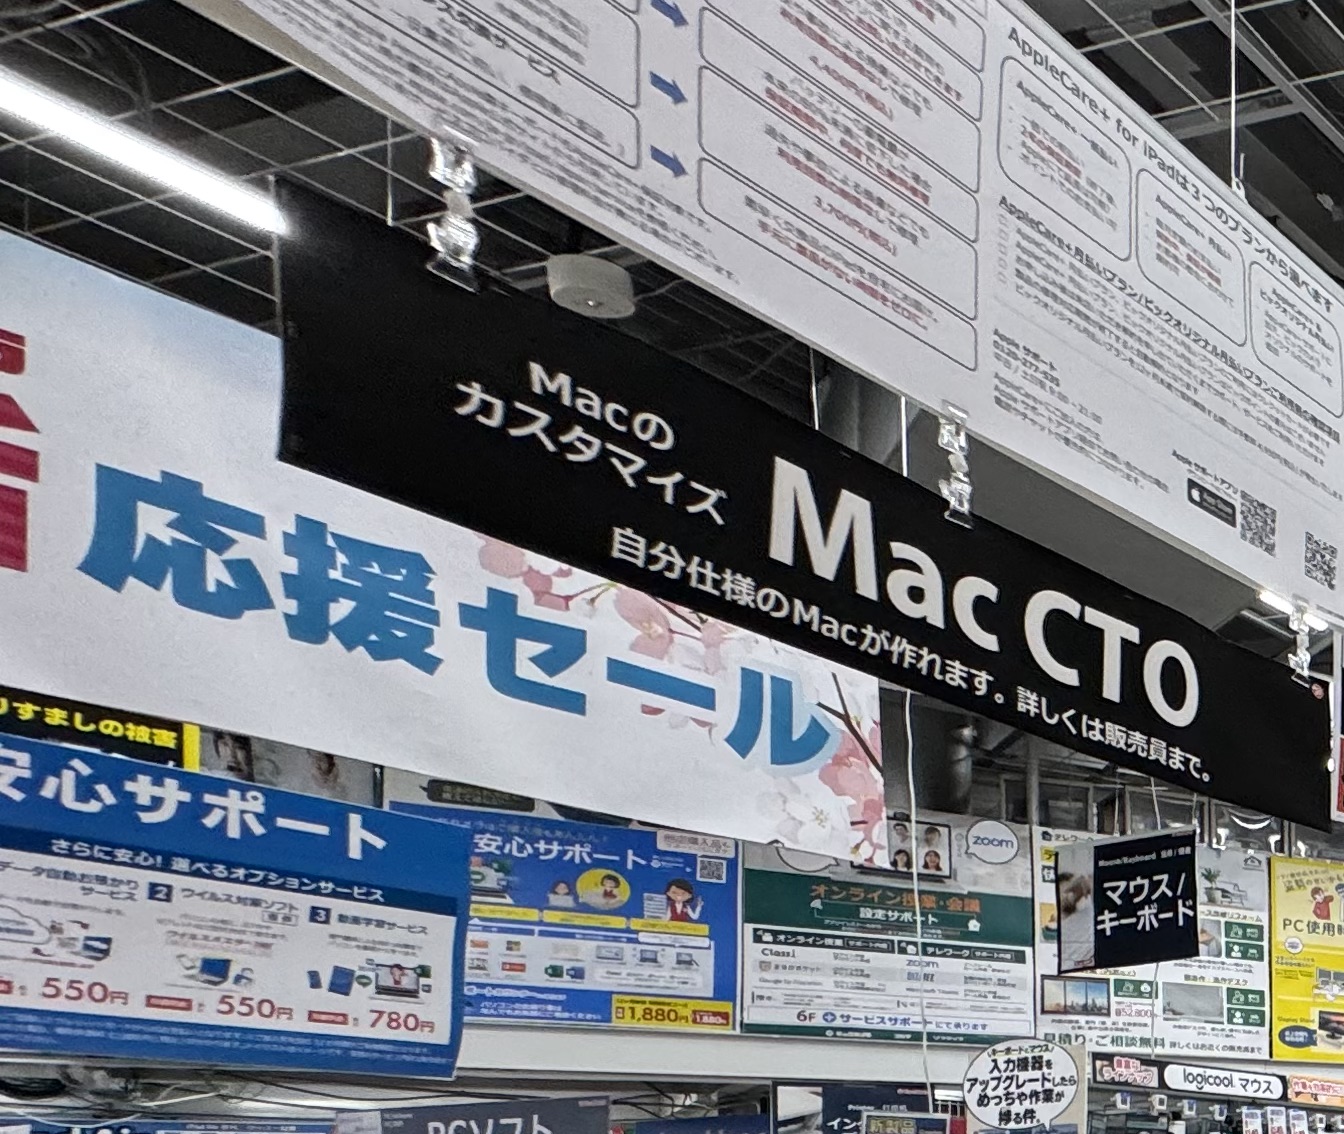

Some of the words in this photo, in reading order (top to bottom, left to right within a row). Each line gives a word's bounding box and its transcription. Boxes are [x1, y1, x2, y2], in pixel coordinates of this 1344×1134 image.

[1008, 27, 1111, 125] AppleCare+
[1115, 117, 1140, 149] for
[528, 359, 676, 452] Macの
[454, 380, 727, 526] カスタマイズ
[767, 454, 1001, 653] Mac
[1024, 588, 1200, 731] CTO
[78, 460, 830, 771] 応援セール
[472, 833, 648, 868] 安心サポート
[972, 835, 1014, 849] zoom
[1103, 872, 1186, 906] マウス/
[1096, 899, 1195, 936] キーボード
[42, 978, 130, 1006] 550円
[216, 997, 294, 1021] 550円
[369, 1009, 435, 1034] 780円
[1182, 1068, 1235, 1089] logicool
[1237, 1077, 1275, 1096] マウス
